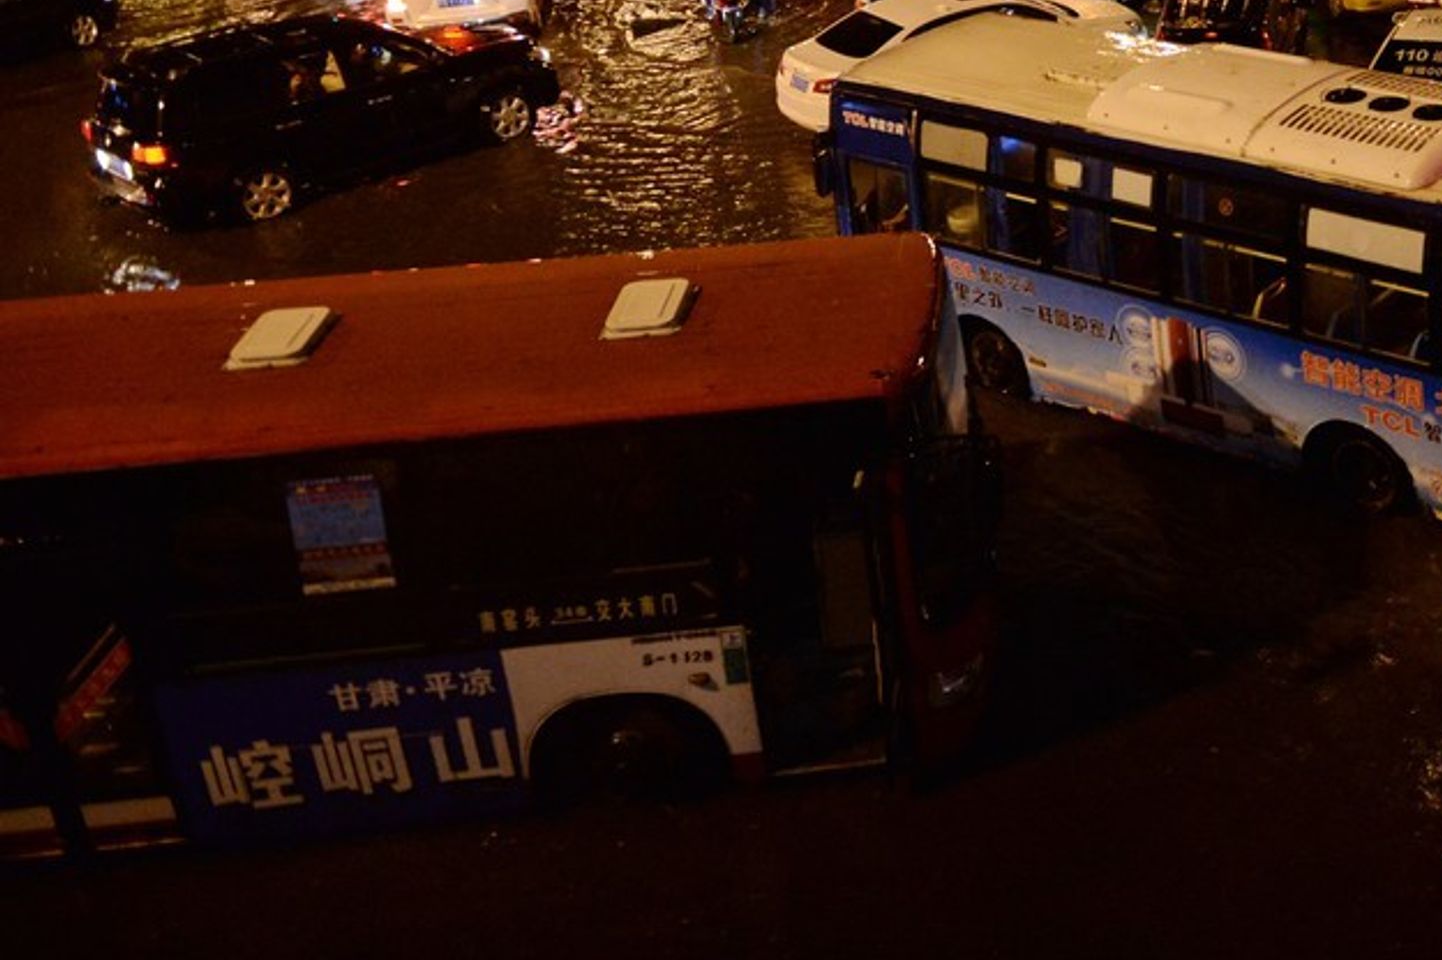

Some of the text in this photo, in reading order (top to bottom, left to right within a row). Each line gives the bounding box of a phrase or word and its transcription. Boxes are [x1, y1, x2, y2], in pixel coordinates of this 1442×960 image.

[1394, 48, 1430, 63] 110
[1299, 349, 1426, 413] 智能空调
[1361, 404, 1421, 438] TCL
[200, 715, 517, 810] 崆峒山
